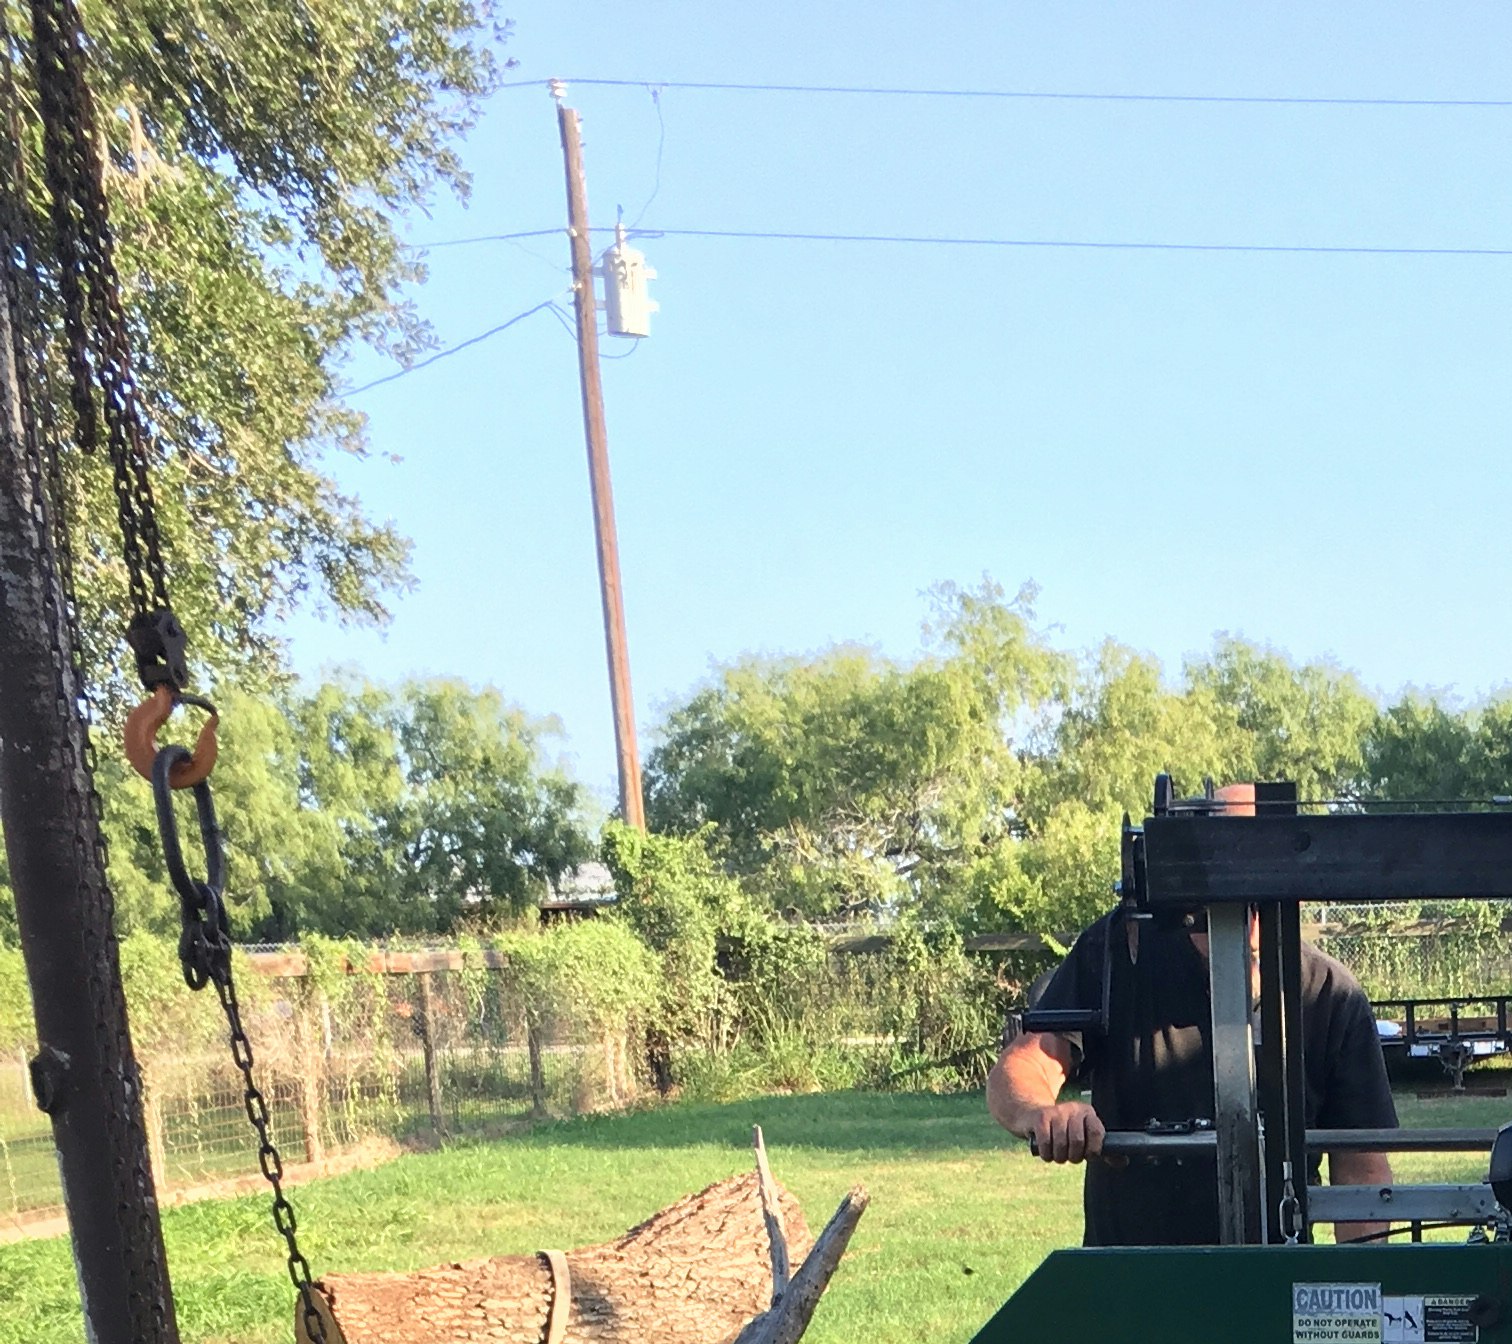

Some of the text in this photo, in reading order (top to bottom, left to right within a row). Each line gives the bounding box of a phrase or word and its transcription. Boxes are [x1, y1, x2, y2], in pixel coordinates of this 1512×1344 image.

[1296, 1288, 1378, 1311] CAUTION
[1298, 1318, 1378, 1328] DO NOT OPERATE
[1295, 1330, 1380, 1340] WITHOUT GUARDS
